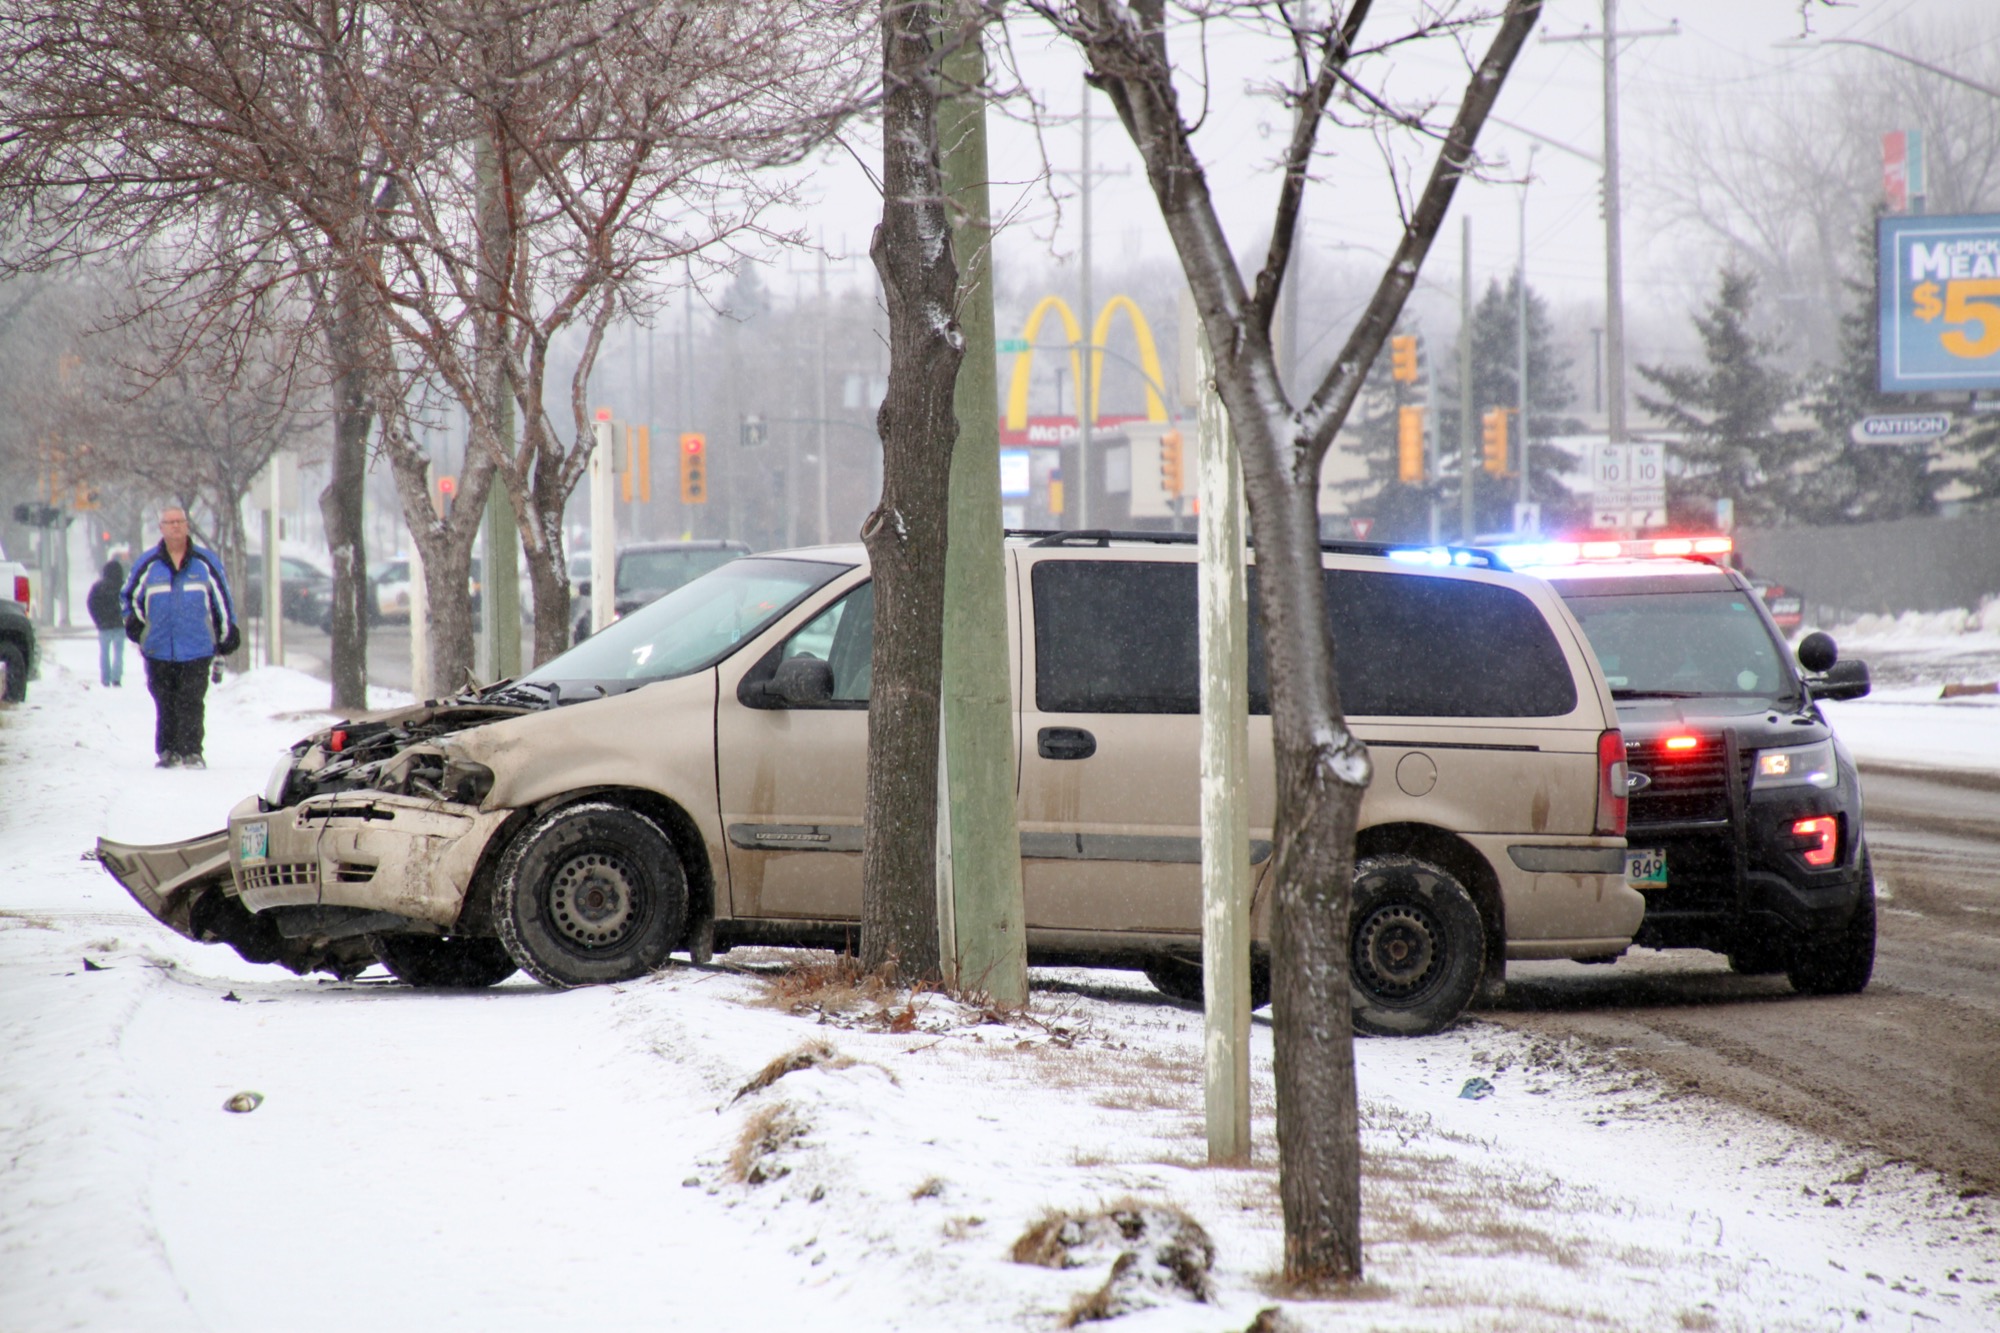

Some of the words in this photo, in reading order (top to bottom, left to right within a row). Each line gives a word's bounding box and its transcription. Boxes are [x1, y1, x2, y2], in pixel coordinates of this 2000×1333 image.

[1869, 418, 1944, 433] PATTISON
[1603, 464, 1619, 481] 10
[1640, 463, 1656, 480] 10
[1632, 859, 1663, 878] 849
